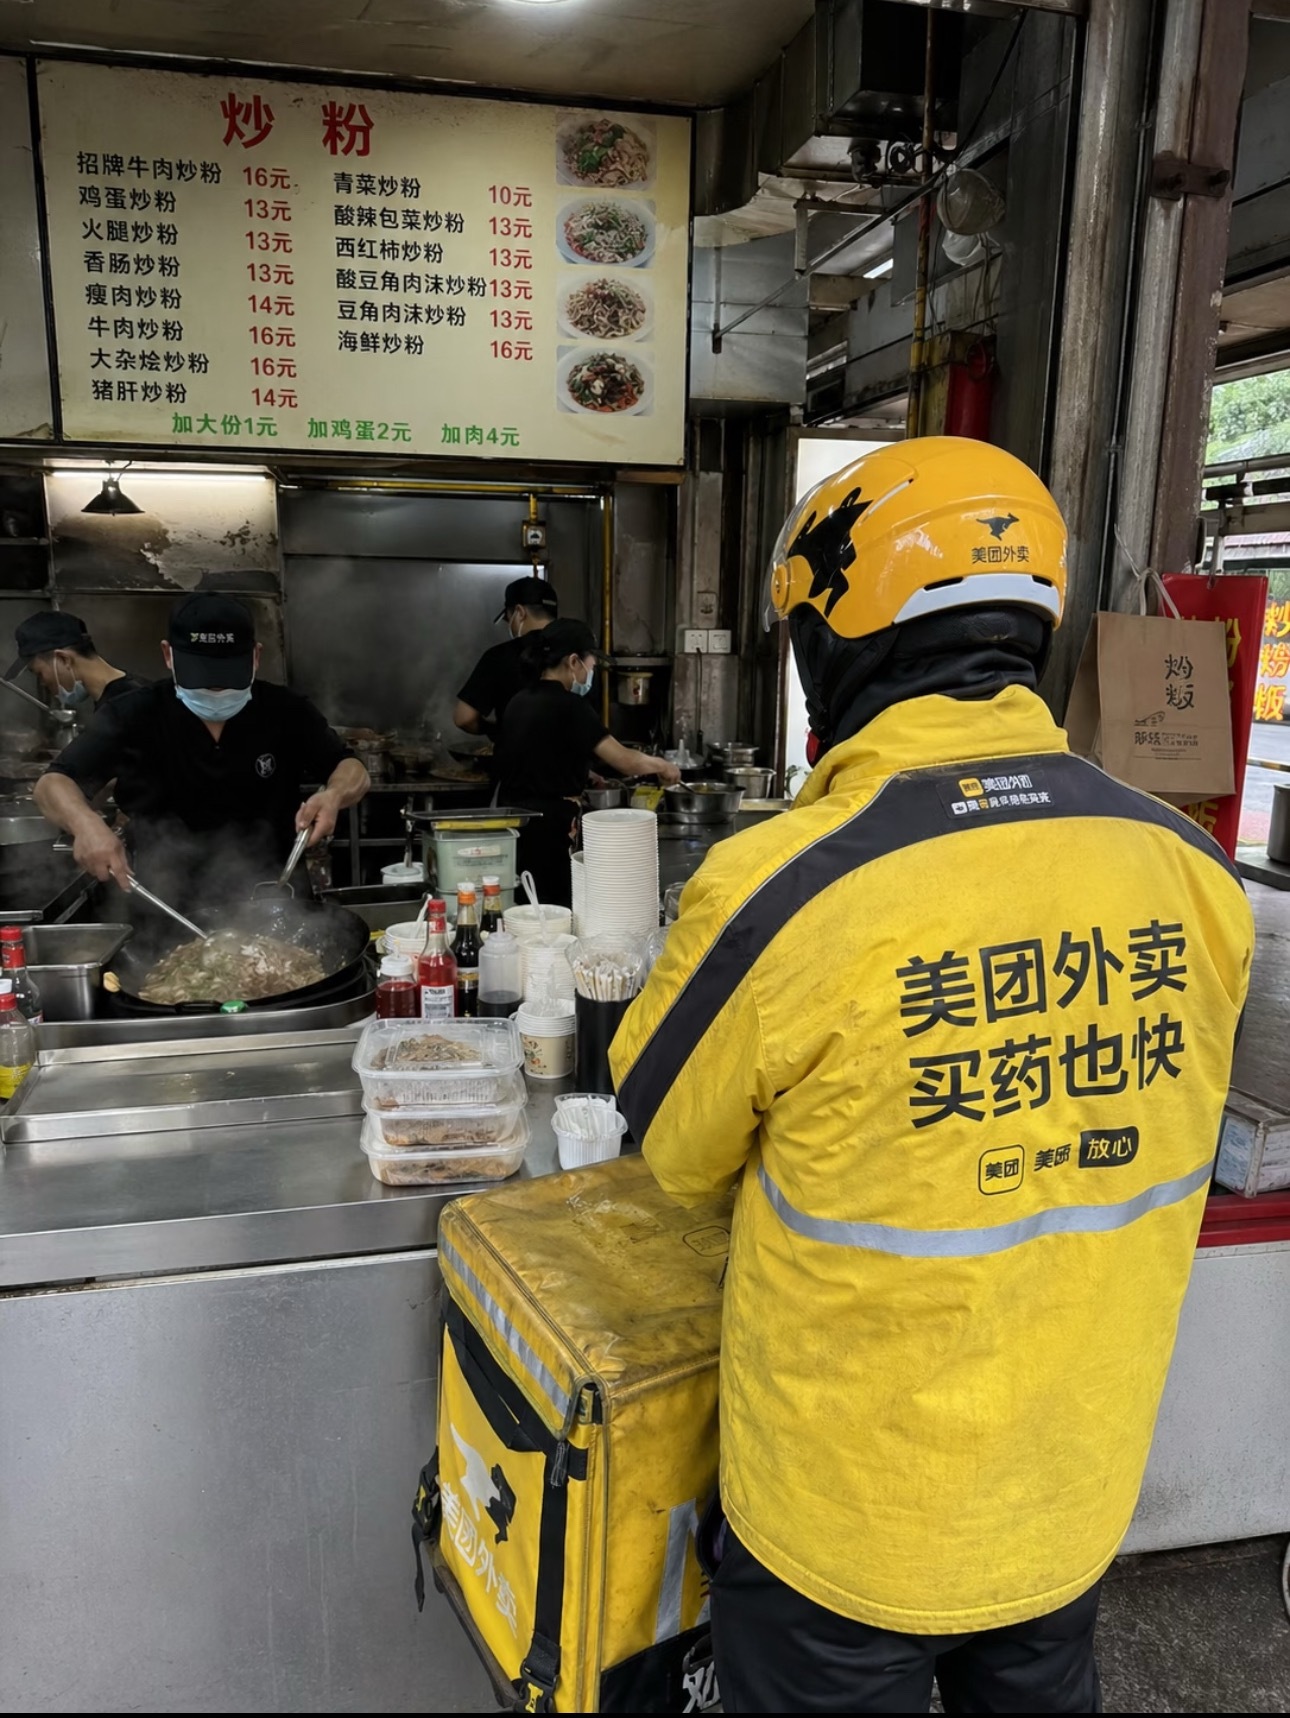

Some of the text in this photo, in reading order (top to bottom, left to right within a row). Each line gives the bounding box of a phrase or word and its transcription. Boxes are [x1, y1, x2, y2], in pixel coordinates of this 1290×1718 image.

[219, 92, 375, 157] 炒 粉
[77, 151, 291, 189] 招牌牛肉炒粉 16元
[79, 185, 292, 221] 鸡蛋炒粉 13元
[333, 172, 533, 207] 青菜炒粉 10元
[82, 218, 293, 254] 火腿炒粉 13元
[334, 205, 533, 239] 酸辣包菜炒粉 13元
[83, 250, 294, 285] 香肠炒粉 13元
[335, 237, 533, 270] 西红柿炒粉 13元
[85, 283, 295, 317] 瘦肉炒粉 14元
[489, 279, 533, 301] 13元
[88, 315, 296, 348] 牛肉炒粉 16元
[489, 310, 533, 331] 13元
[90, 347, 297, 379] 大杂烩炒粉 16元
[337, 330, 533, 361] 海鲜炒粉 16元
[92, 379, 298, 409] 猪肝炒粉 14元
[172, 412, 520, 447] 加大份1元 加鸡蛋2元 加肉4元
[896, 919, 1188, 1038] 美团外卖
[909, 1013, 1185, 1129] 买药也快
[985, 1158, 1020, 1182] 美团
[1087, 1136, 1132, 1161] 放心
